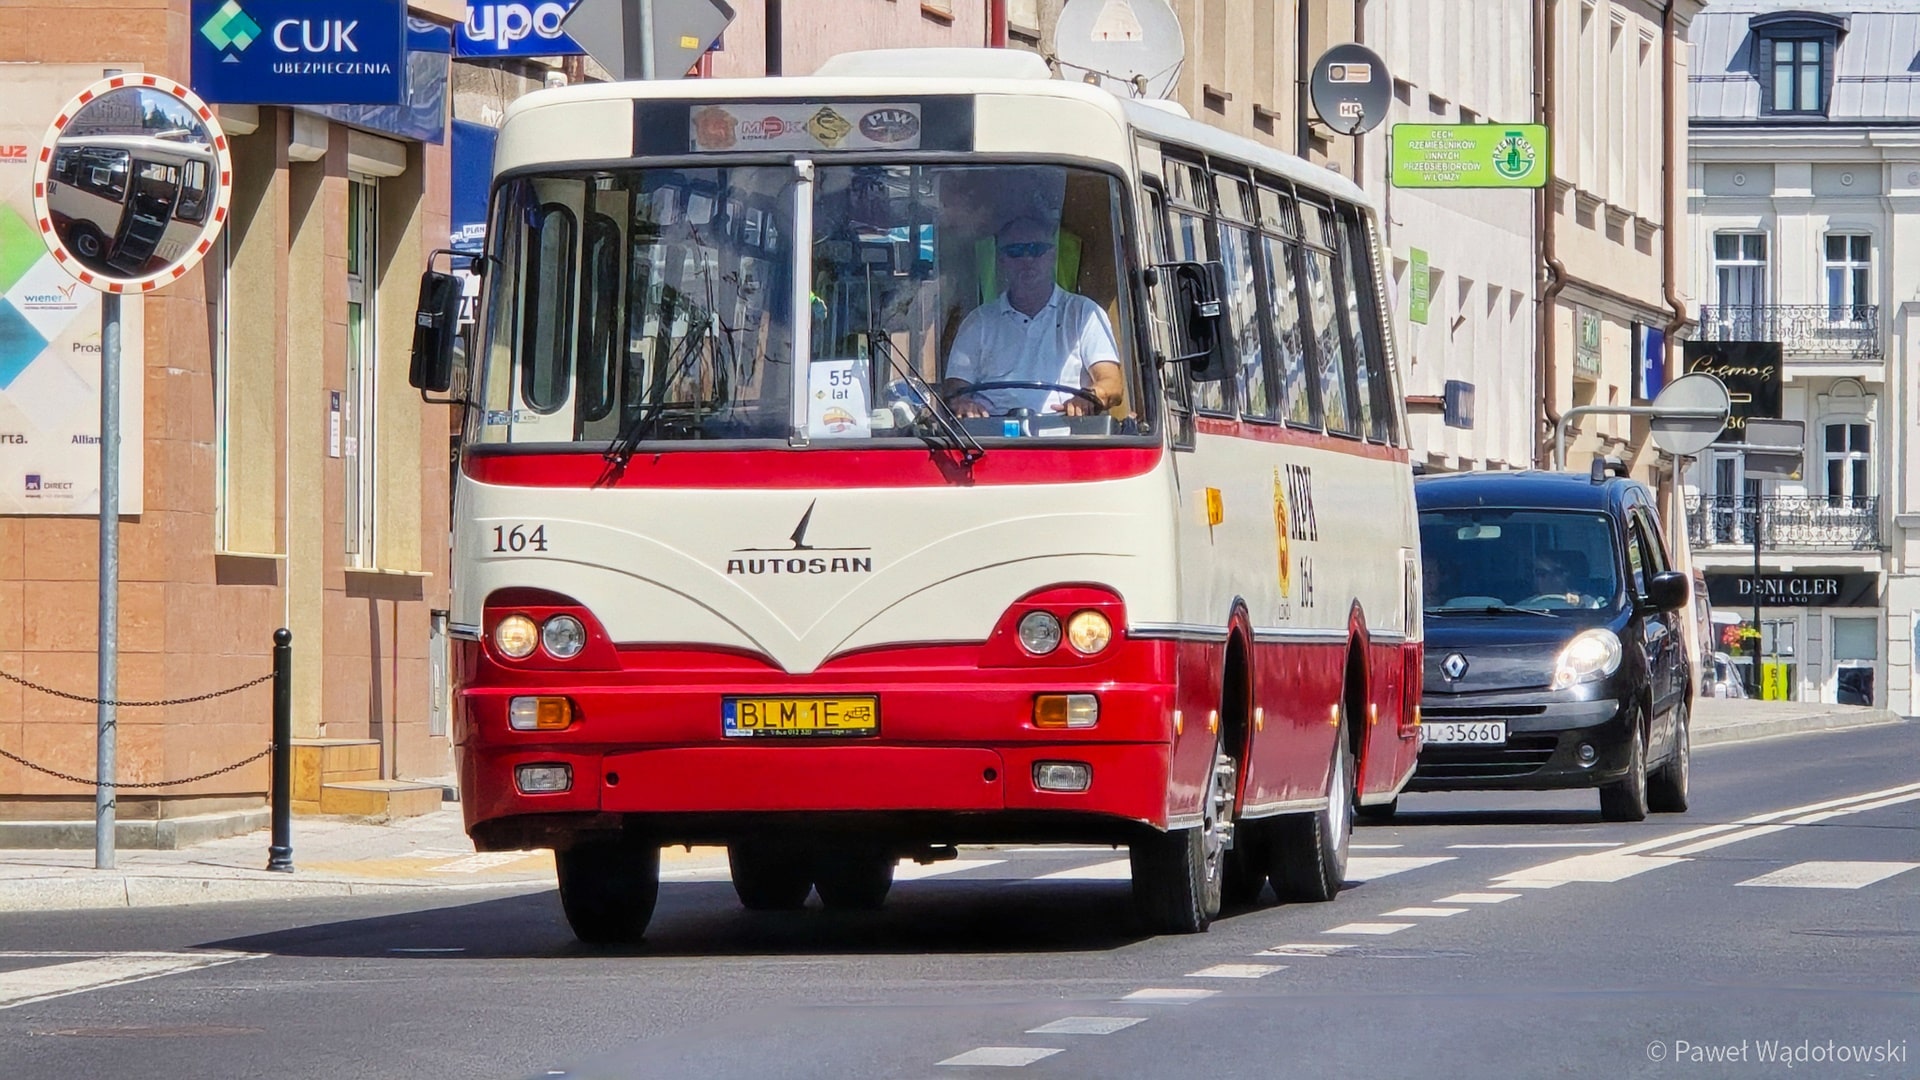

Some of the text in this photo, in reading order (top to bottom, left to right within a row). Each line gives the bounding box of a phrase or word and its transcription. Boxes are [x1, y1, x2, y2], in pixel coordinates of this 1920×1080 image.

[464, 1, 575, 49] upo
[273, 19, 359, 53] CUK
[273, 62, 391, 75] UBEZPIECZENIA
[1341, 105, 1360, 115] HD
[867, 111, 913, 126] PLW
[741, 120, 800, 141] MPK
[24, 295, 63, 303] wiener
[73, 343, 101, 353] Proa
[830, 370, 852, 386] 55
[832, 389, 848, 400] lat
[72, 435, 101, 444] Allian
[493, 524, 548, 552] 164
[727, 557, 872, 574] AUTOSAN
[1739, 578, 1838, 595] DENI CLER
[726, 718, 736, 726] PL
[742, 702, 839, 727] BLM 1E
[1446, 724, 1501, 741] 35660
